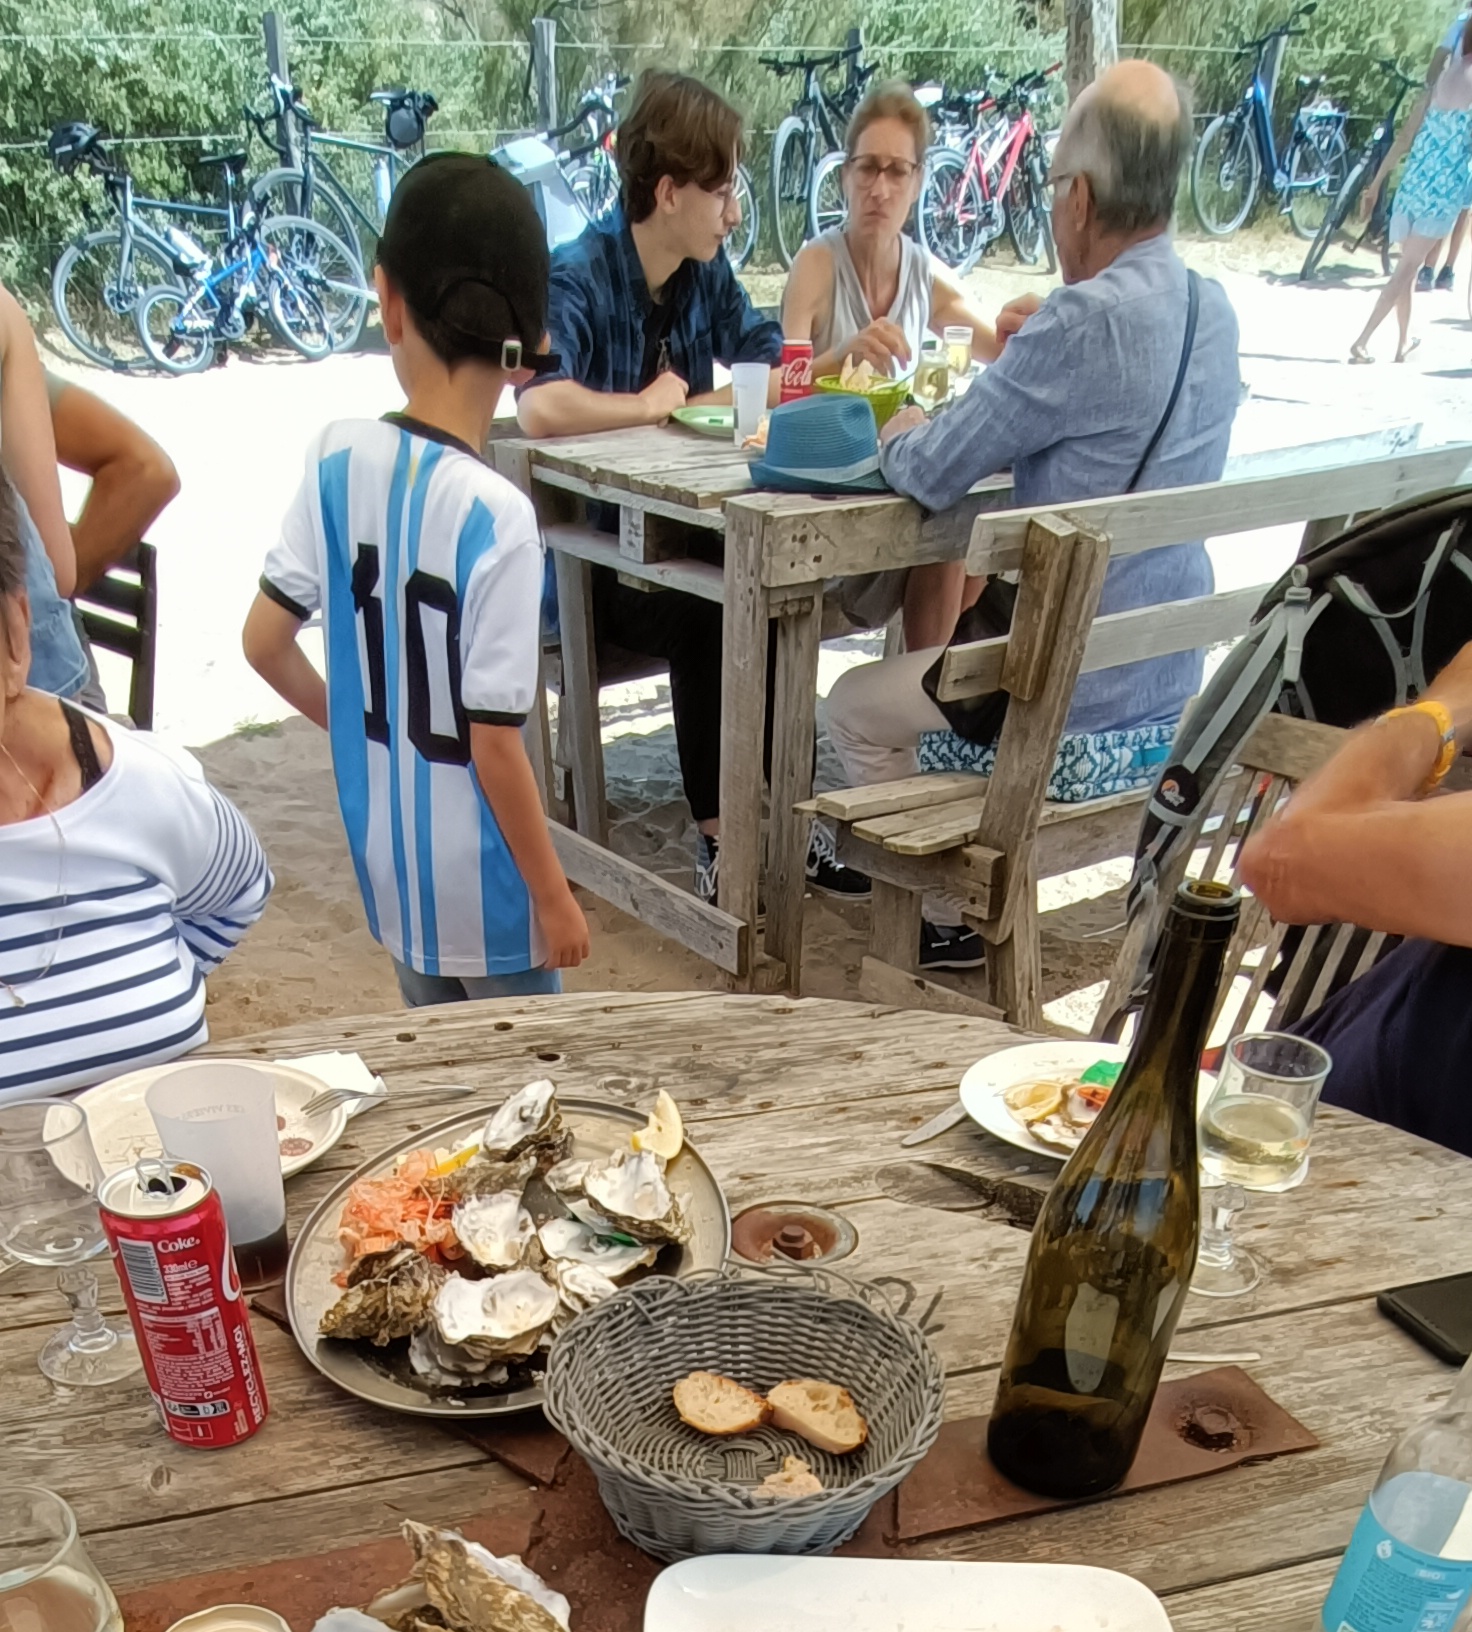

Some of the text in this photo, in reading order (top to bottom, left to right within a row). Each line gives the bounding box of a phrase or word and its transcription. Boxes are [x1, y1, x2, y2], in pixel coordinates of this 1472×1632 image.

[351, 541, 472, 769] 10
[157, 1236, 195, 1253] Coke
[232, 1323, 263, 1425] RECYCLEZ-MOI
